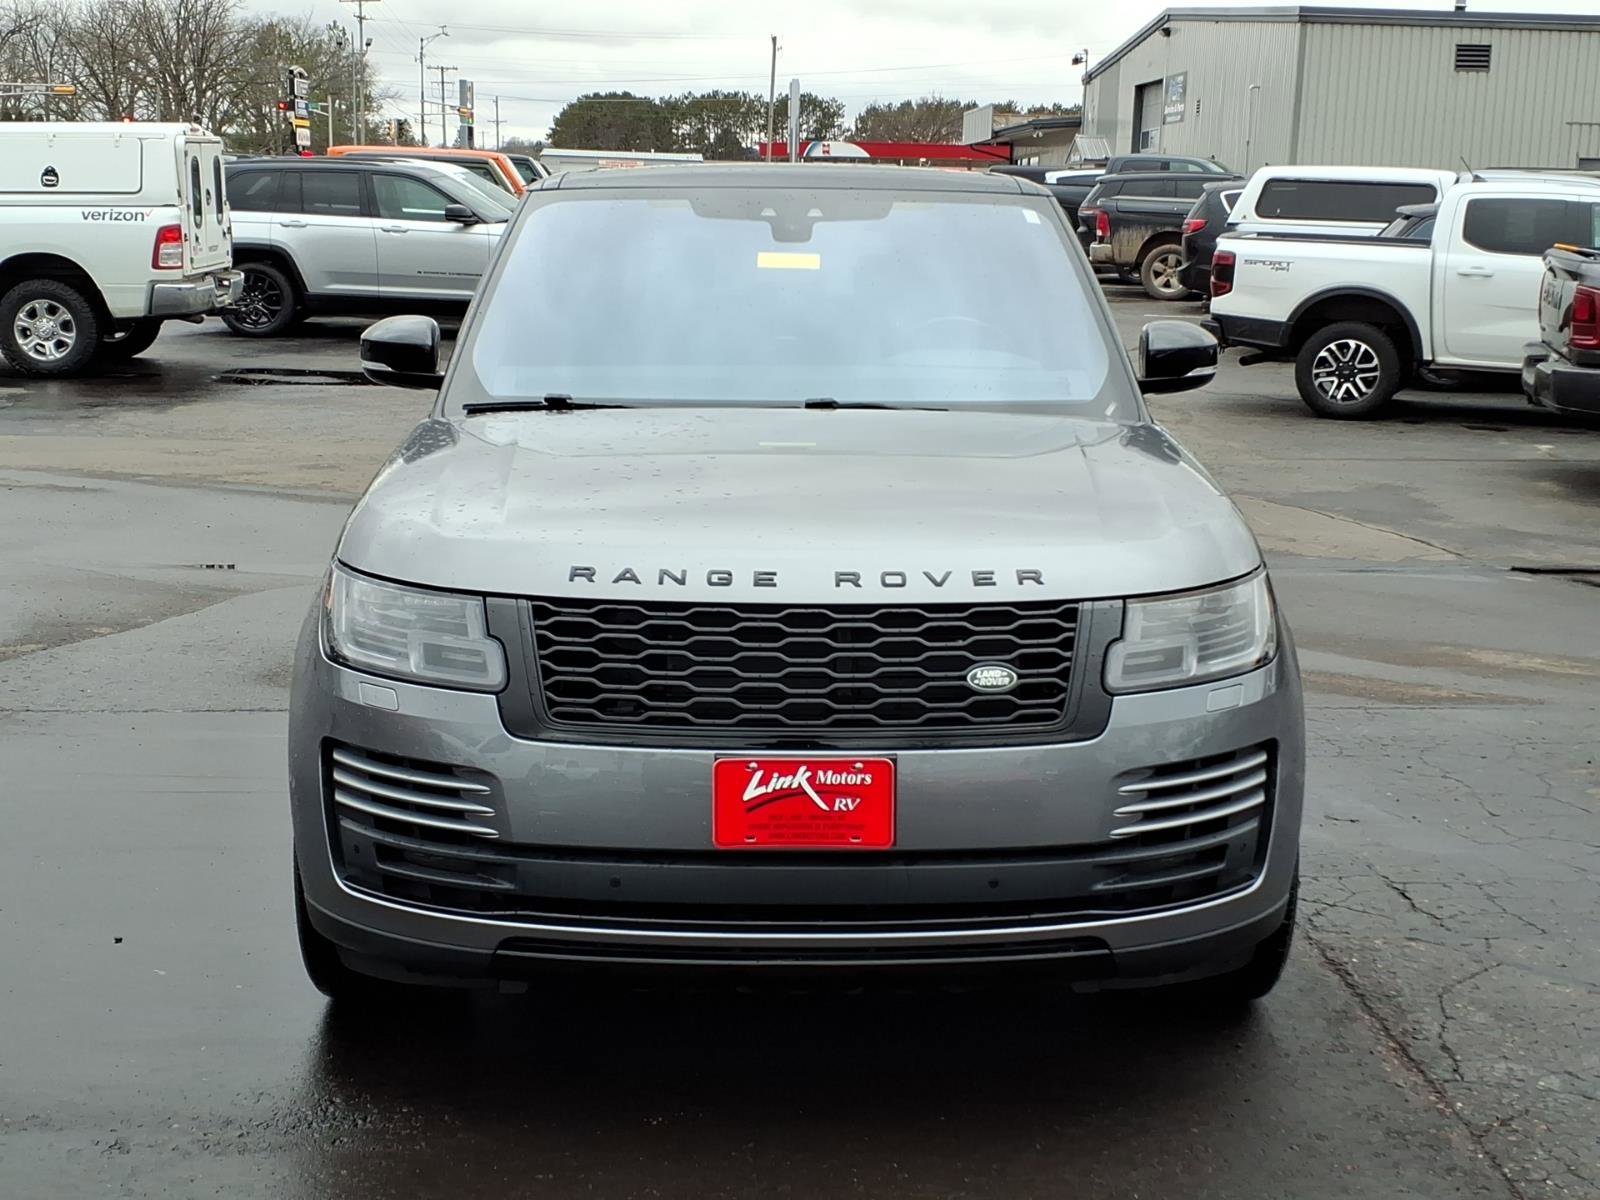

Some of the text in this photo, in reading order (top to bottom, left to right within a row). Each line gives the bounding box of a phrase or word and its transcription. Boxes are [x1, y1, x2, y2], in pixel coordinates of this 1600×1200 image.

[81, 208, 145, 222] verizon
[1243, 259, 1295, 267] SPORT
[568, 565, 1046, 588] RANGE ROVER
[976, 669, 1002, 678] LAND
[979, 677, 1010, 686] ROVER
[742, 765, 872, 811] Link Motors
[833, 798, 861, 811] RV
